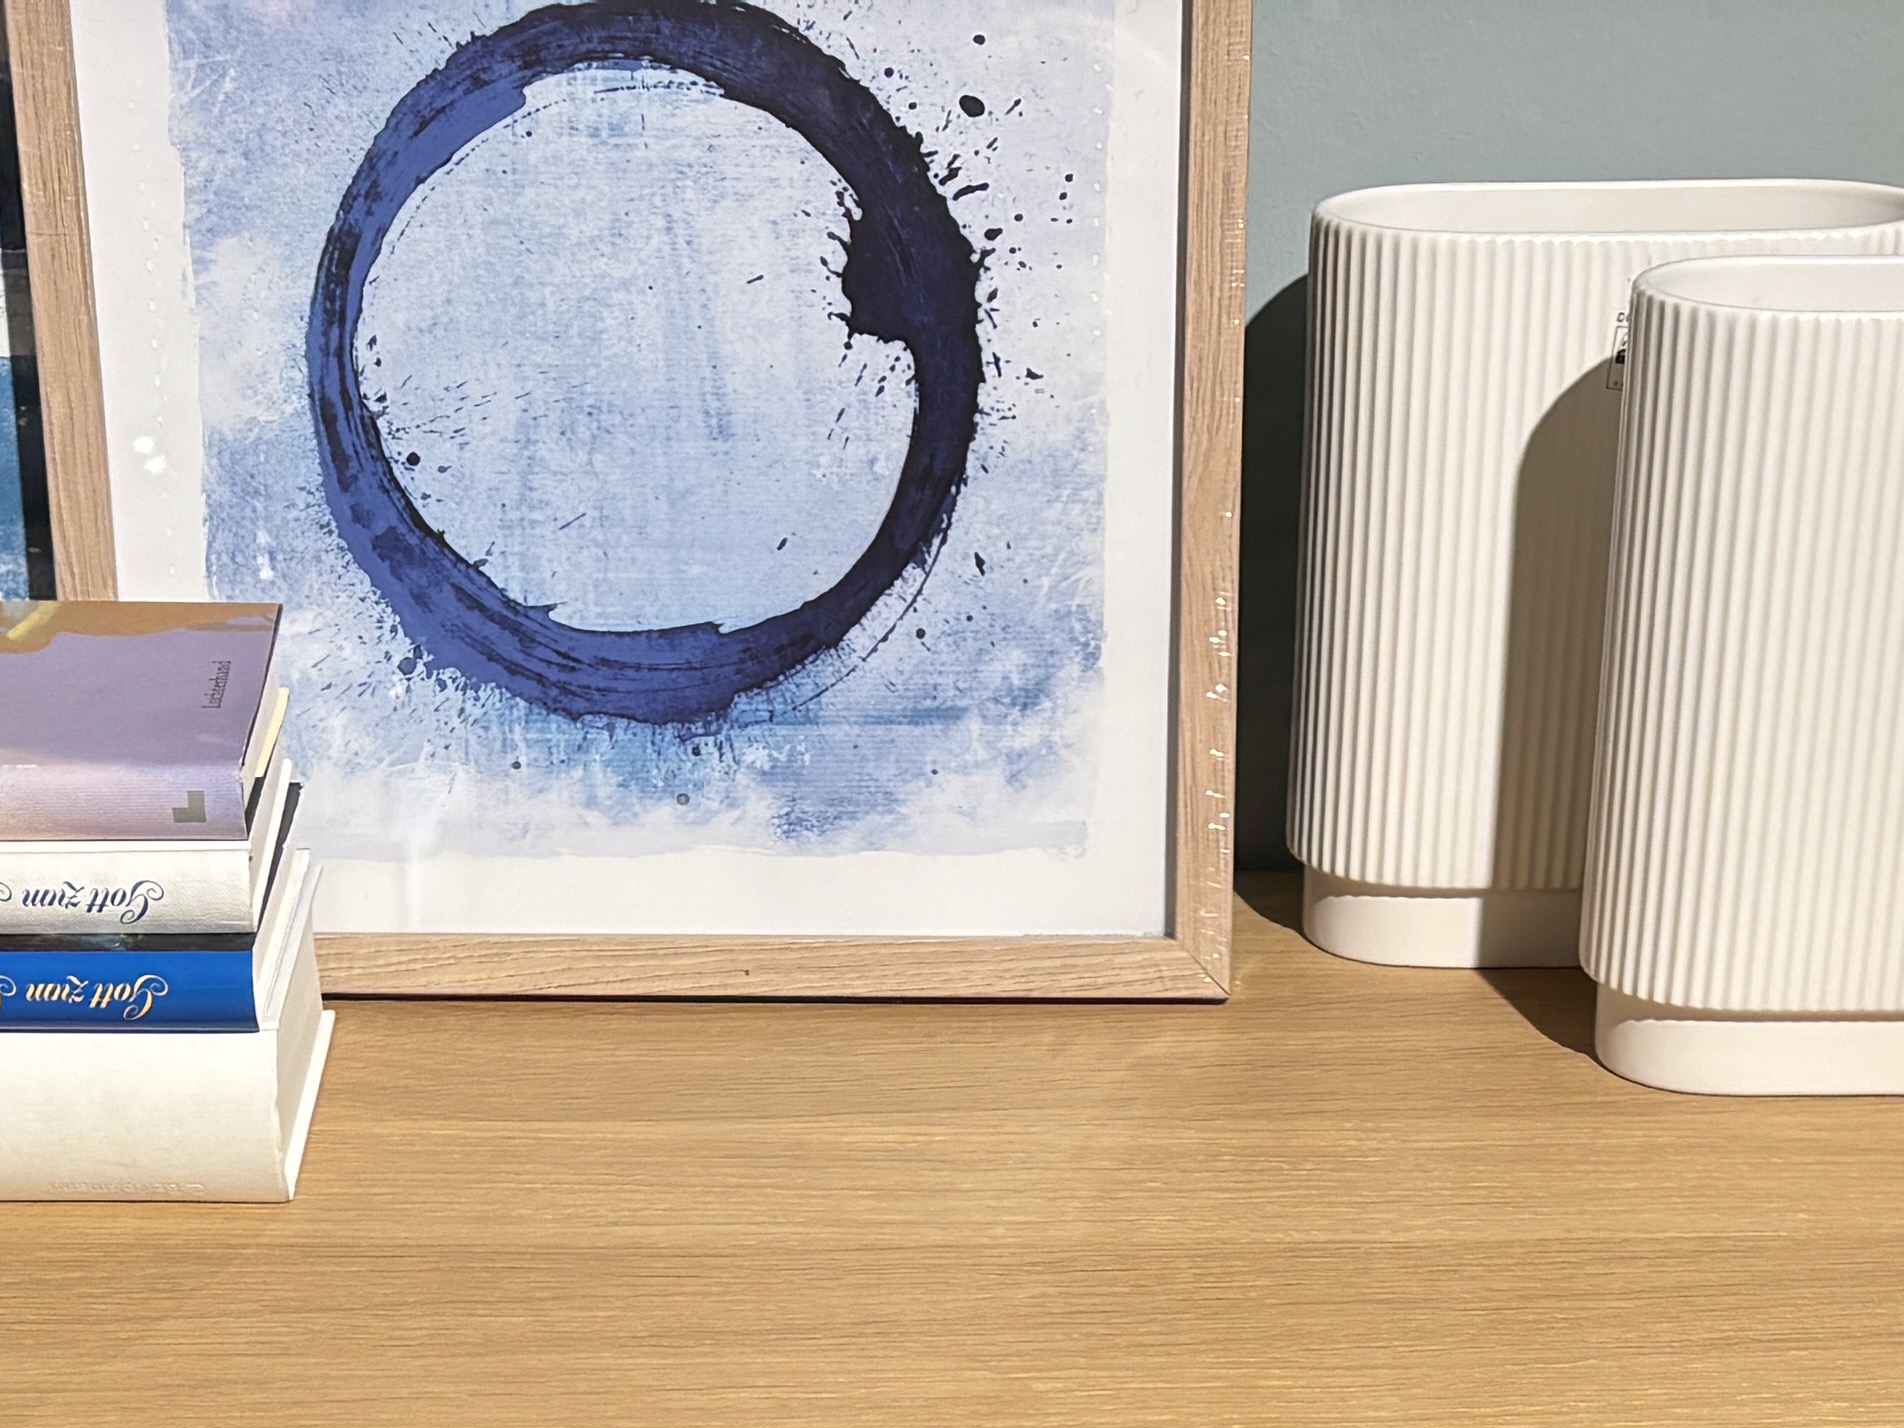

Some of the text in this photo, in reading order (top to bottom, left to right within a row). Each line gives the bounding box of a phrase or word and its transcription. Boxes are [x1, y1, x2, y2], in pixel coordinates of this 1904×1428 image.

[21, 881, 84, 908] zum
[85, 880, 165, 926] Gott
[24, 976, 89, 1003] zum
[89, 974, 170, 1021] Gott
